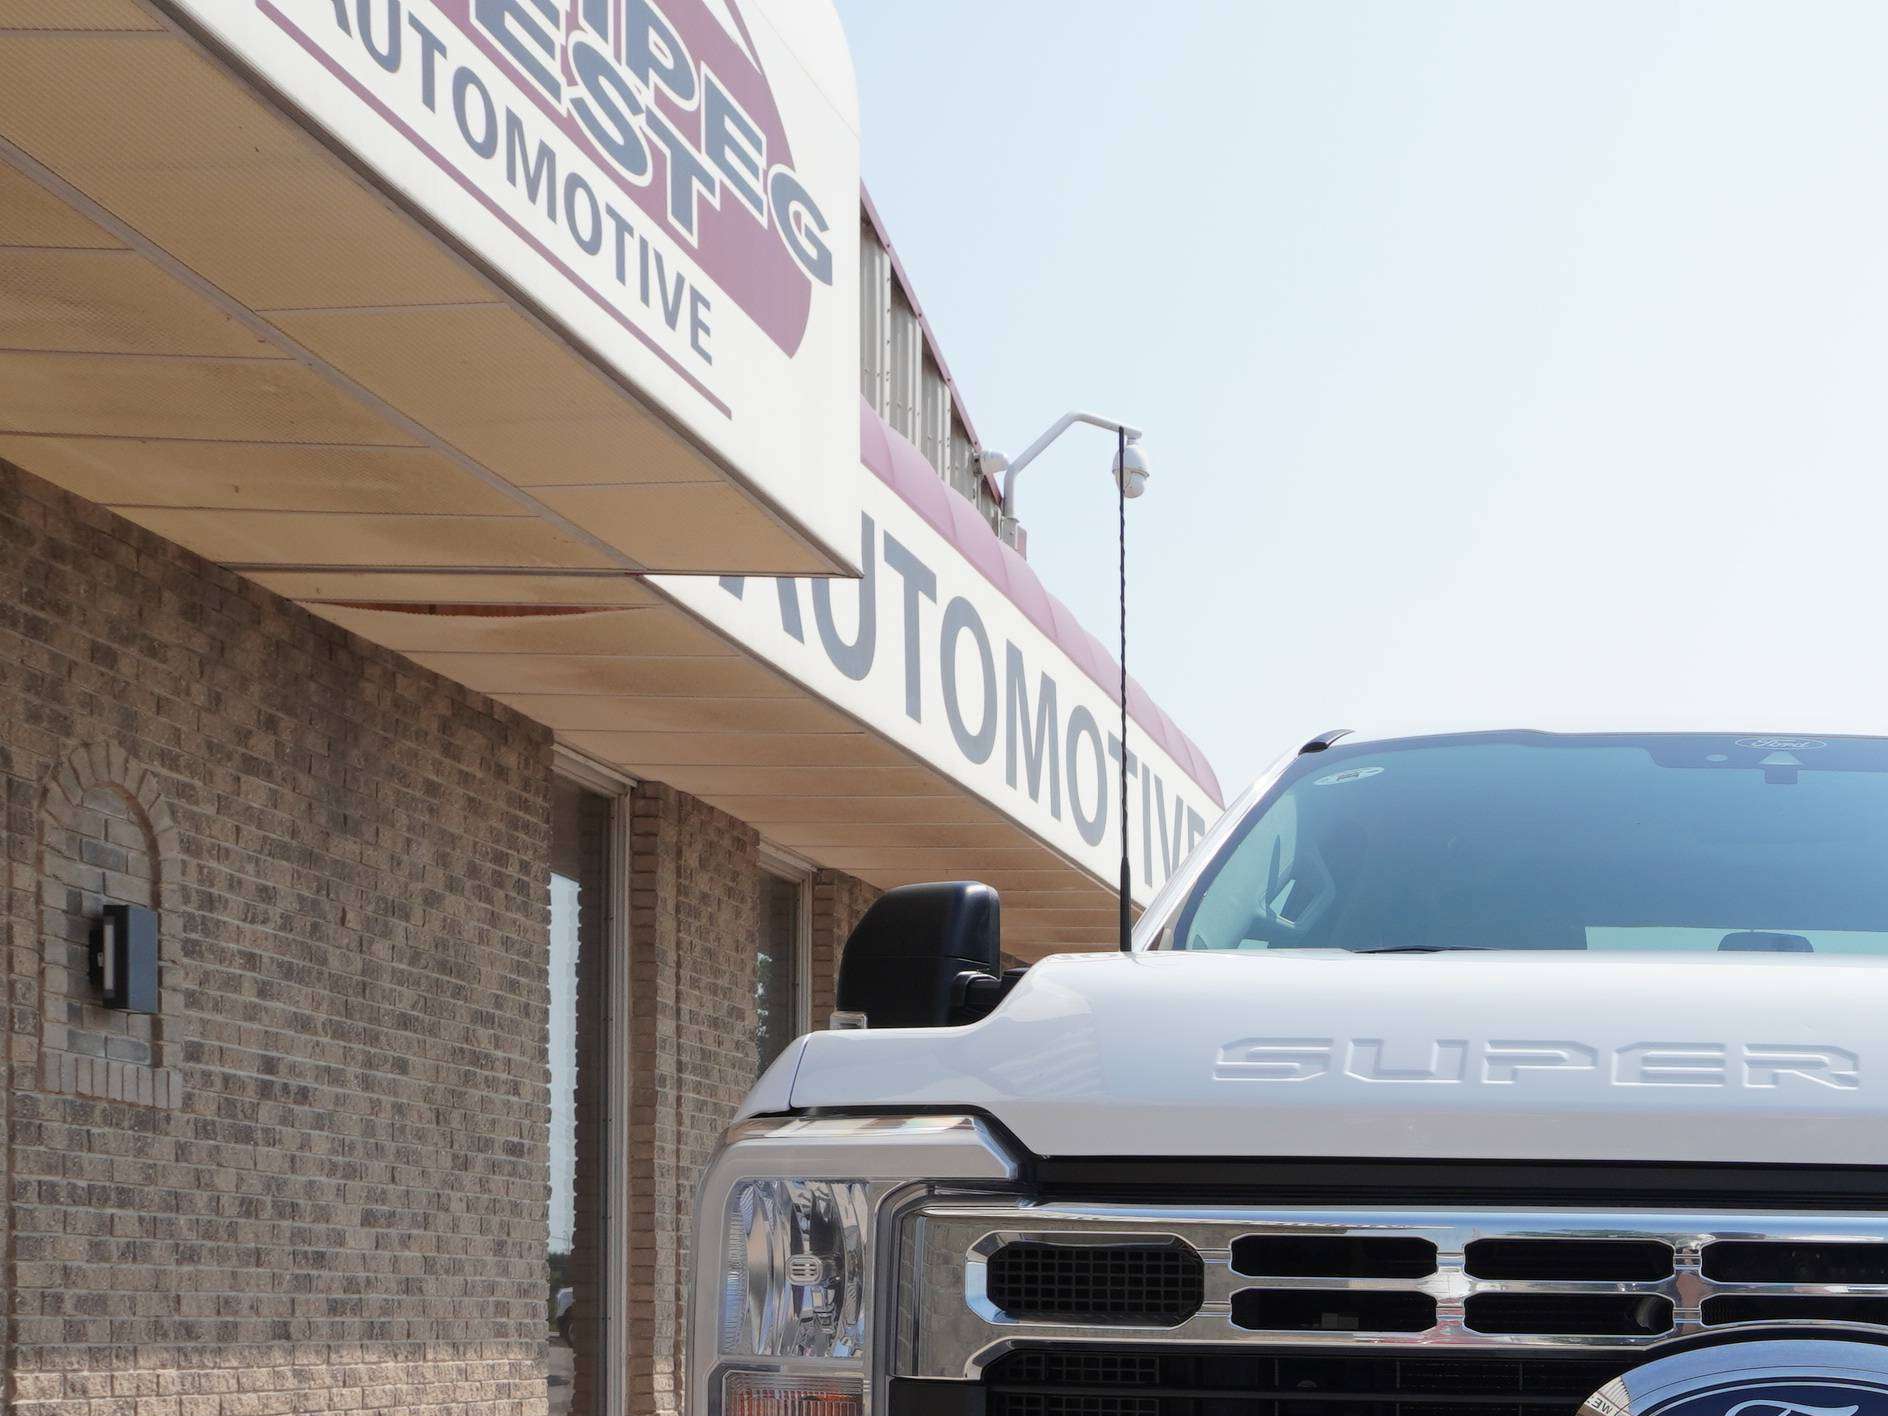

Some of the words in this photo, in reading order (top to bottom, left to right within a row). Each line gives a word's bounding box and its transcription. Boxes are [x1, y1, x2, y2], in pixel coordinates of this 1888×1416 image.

[330, 0, 713, 366] UTOMOTIVE
[718, 510, 1206, 888] UTOMOTIV
[1211, 1037, 1858, 1091] SUPER
